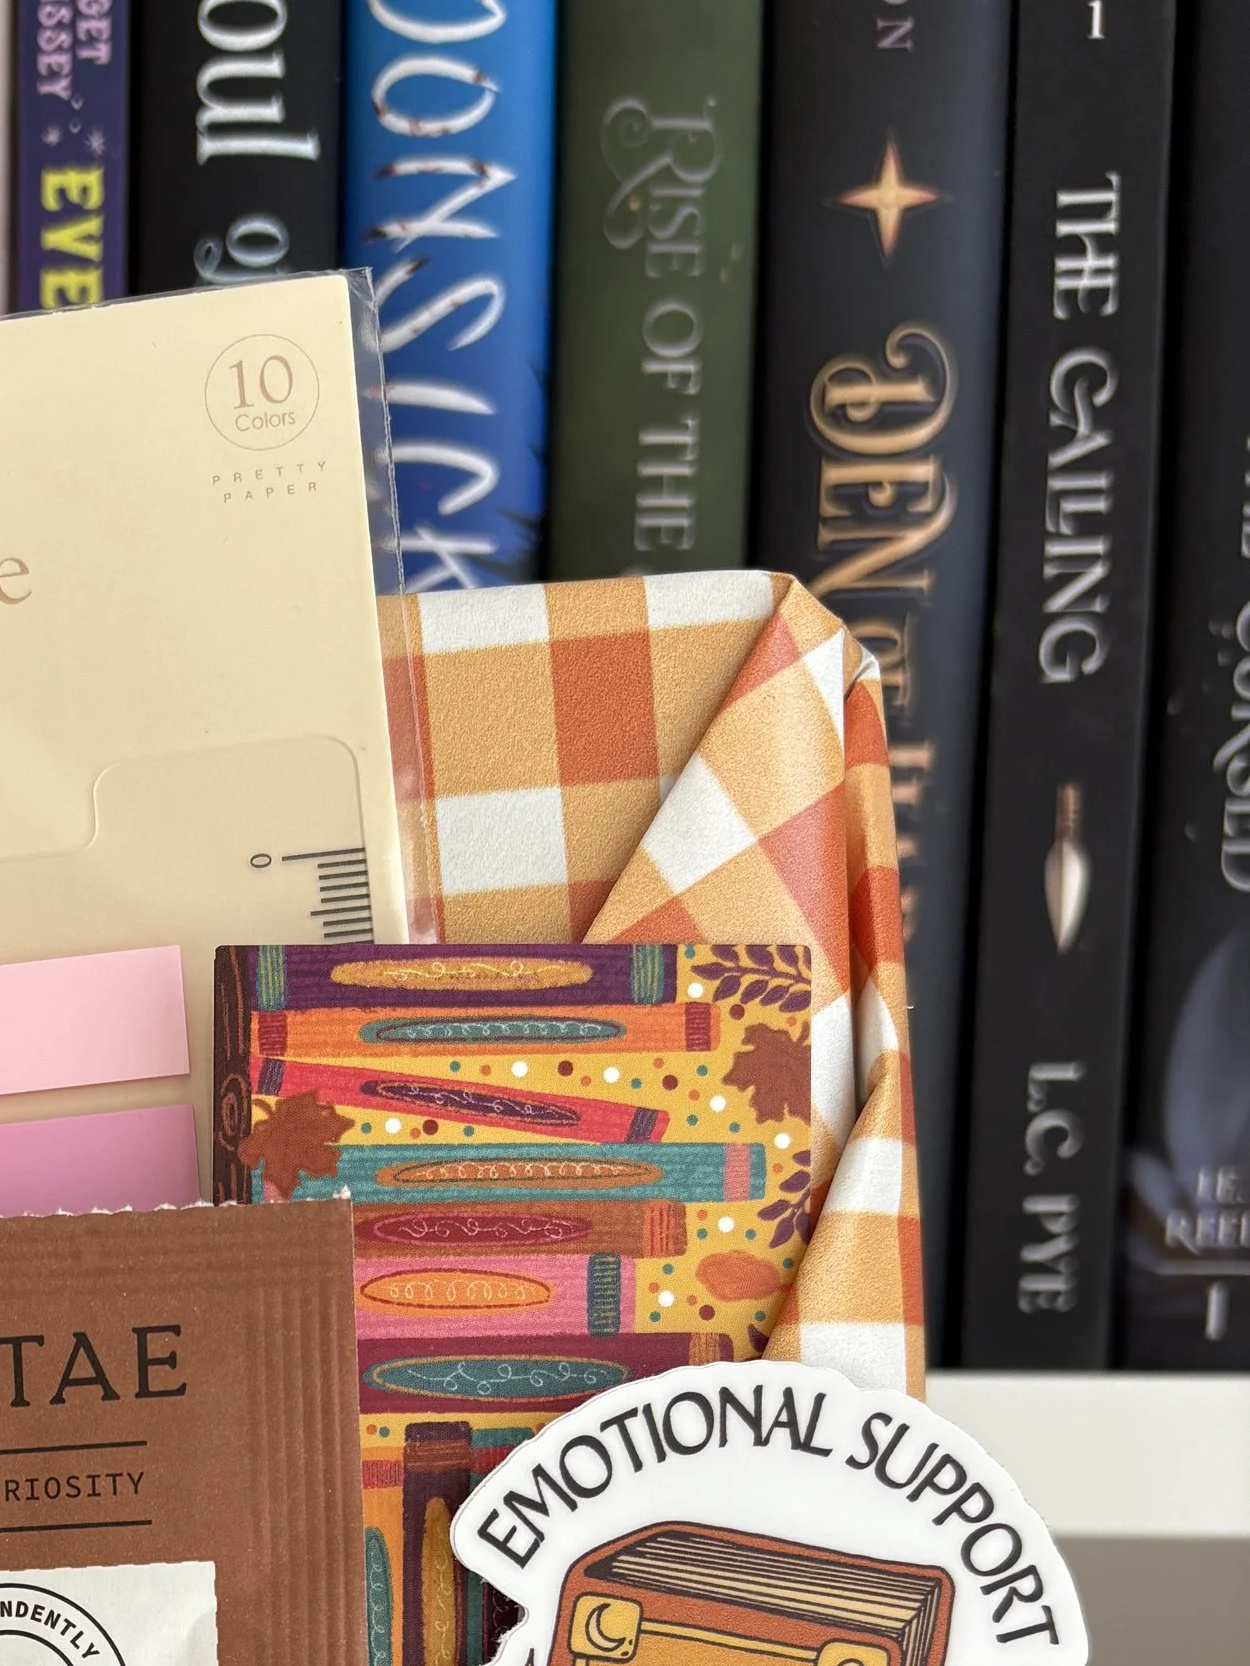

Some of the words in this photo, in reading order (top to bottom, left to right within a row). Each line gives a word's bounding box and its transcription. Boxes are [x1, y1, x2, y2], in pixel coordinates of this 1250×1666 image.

[36, 0, 73, 101] SSEY
[600, 97, 721, 278] RISE
[1053, 171, 1121, 320] THE
[228, 354, 293, 408] 10
[642, 299, 704, 396] OF
[211, 460, 327, 486] PRETTY
[235, 409, 296, 433] Colors
[806, 320, 958, 608] DEN
[223, 481, 318, 503] PAPER
[634, 417, 701, 552] THE
[1038, 347, 1119, 685] CALLING
[1017, 1193, 1082, 1315] PYE
[477, 1385, 833, 1569] EMOTIONAL
[846, 1412, 1062, 1648] SUPPORT
